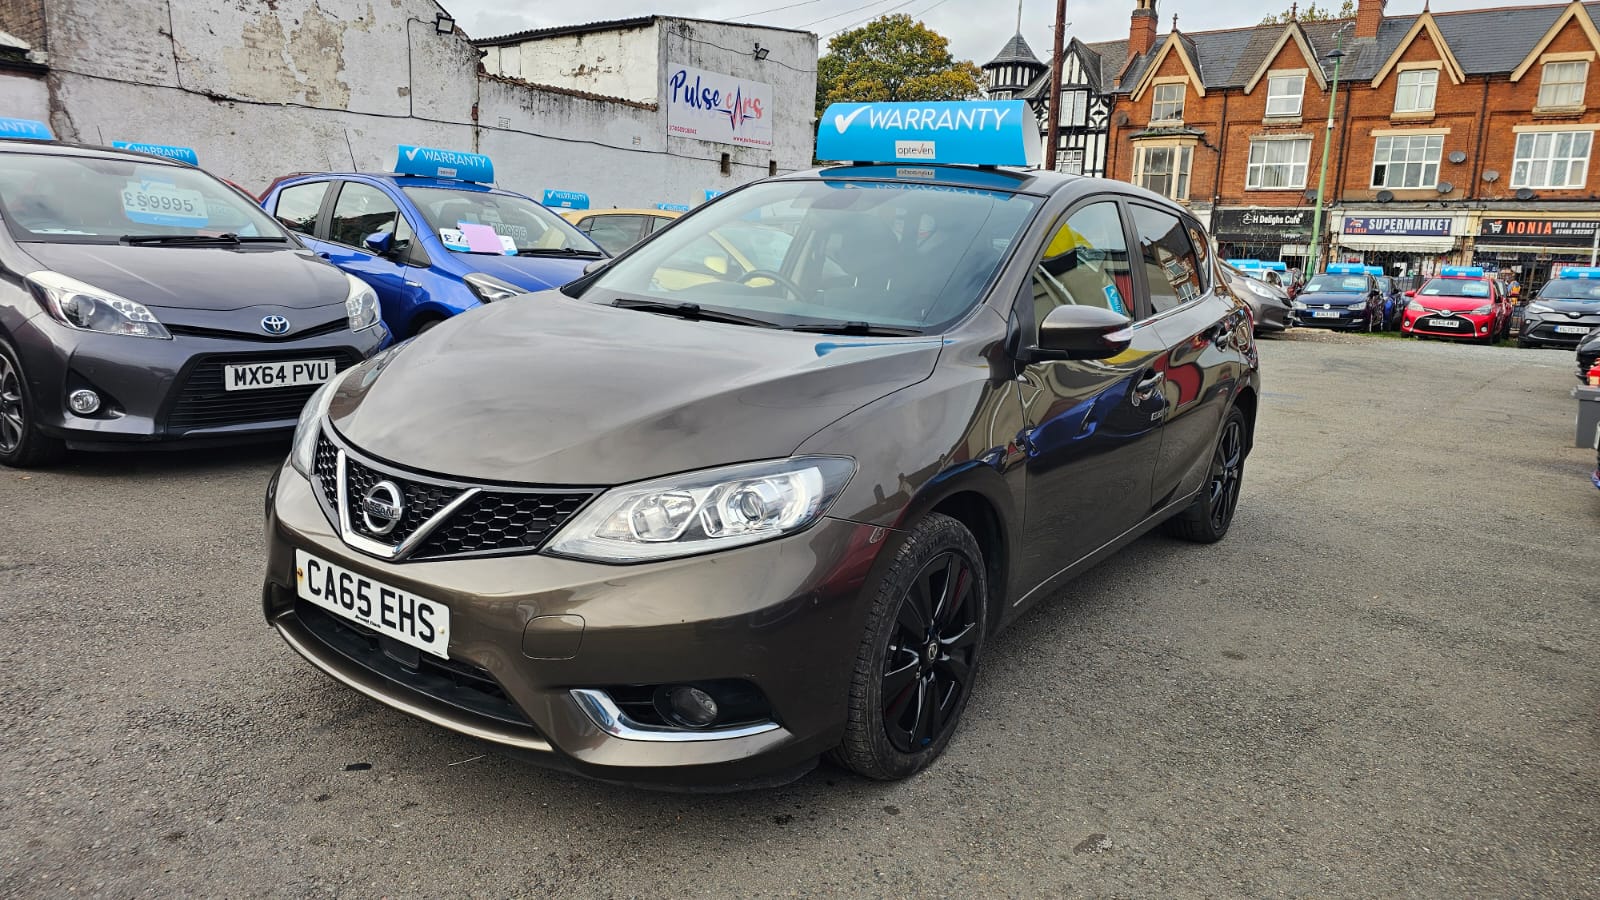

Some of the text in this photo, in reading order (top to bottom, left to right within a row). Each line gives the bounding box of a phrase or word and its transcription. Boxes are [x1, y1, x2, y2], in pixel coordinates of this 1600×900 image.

[669, 70, 721, 110] Pulse
[868, 107, 1011, 131] WARRANTY
[132, 145, 191, 159] WARRANTY
[897, 142, 934, 156] opteven
[421, 149, 486, 168] WARRANTY
[555, 192, 586, 202] WARRANTY
[1368, 218, 1451, 231] SUPERMARKET
[1506, 221, 1552, 235] NONIA
[234, 362, 329, 387] MX64 PVU
[307, 558, 436, 644] CA65 EHS
